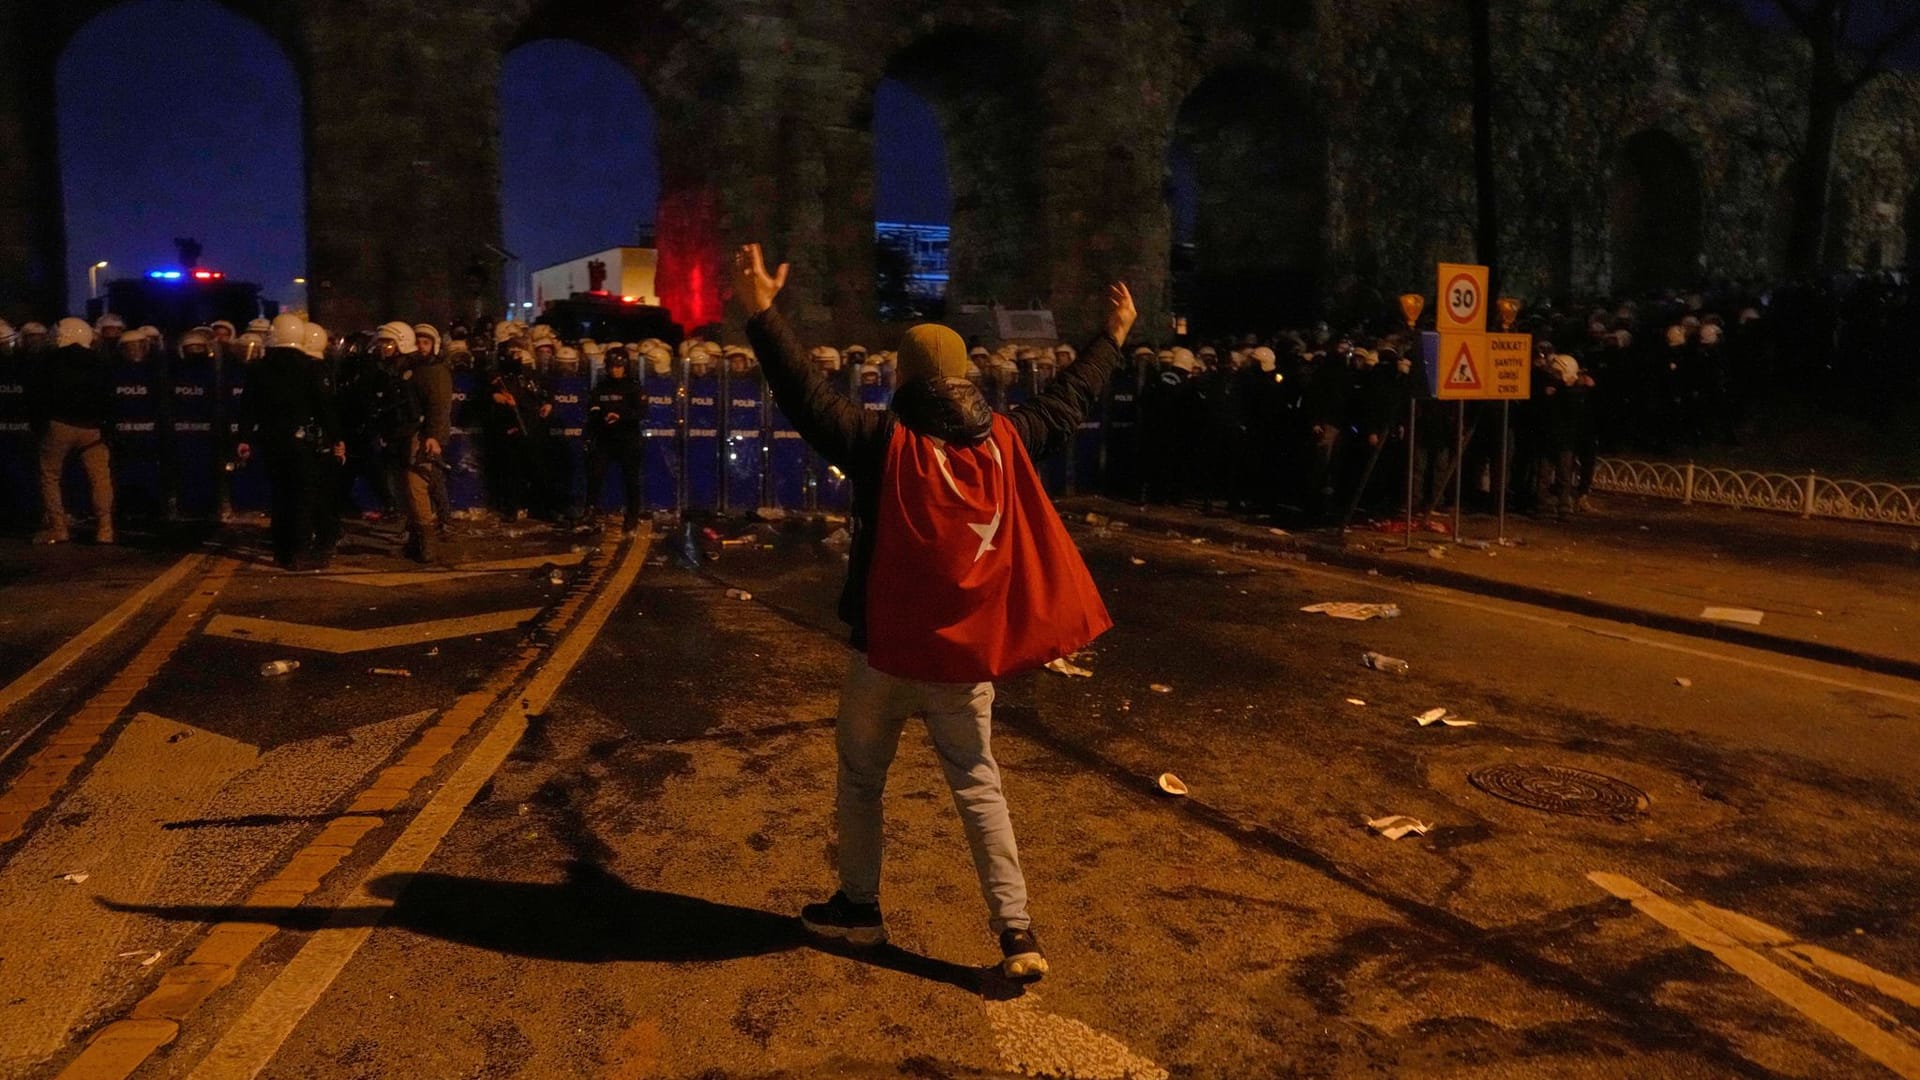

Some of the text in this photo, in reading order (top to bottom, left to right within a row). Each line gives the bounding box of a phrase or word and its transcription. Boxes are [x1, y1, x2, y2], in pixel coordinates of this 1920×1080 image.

[1452, 288, 1474, 308] 30
[0, 384, 23, 394] OLİS
[116, 385, 148, 395] POLİS
[175, 385, 204, 396] POLİS
